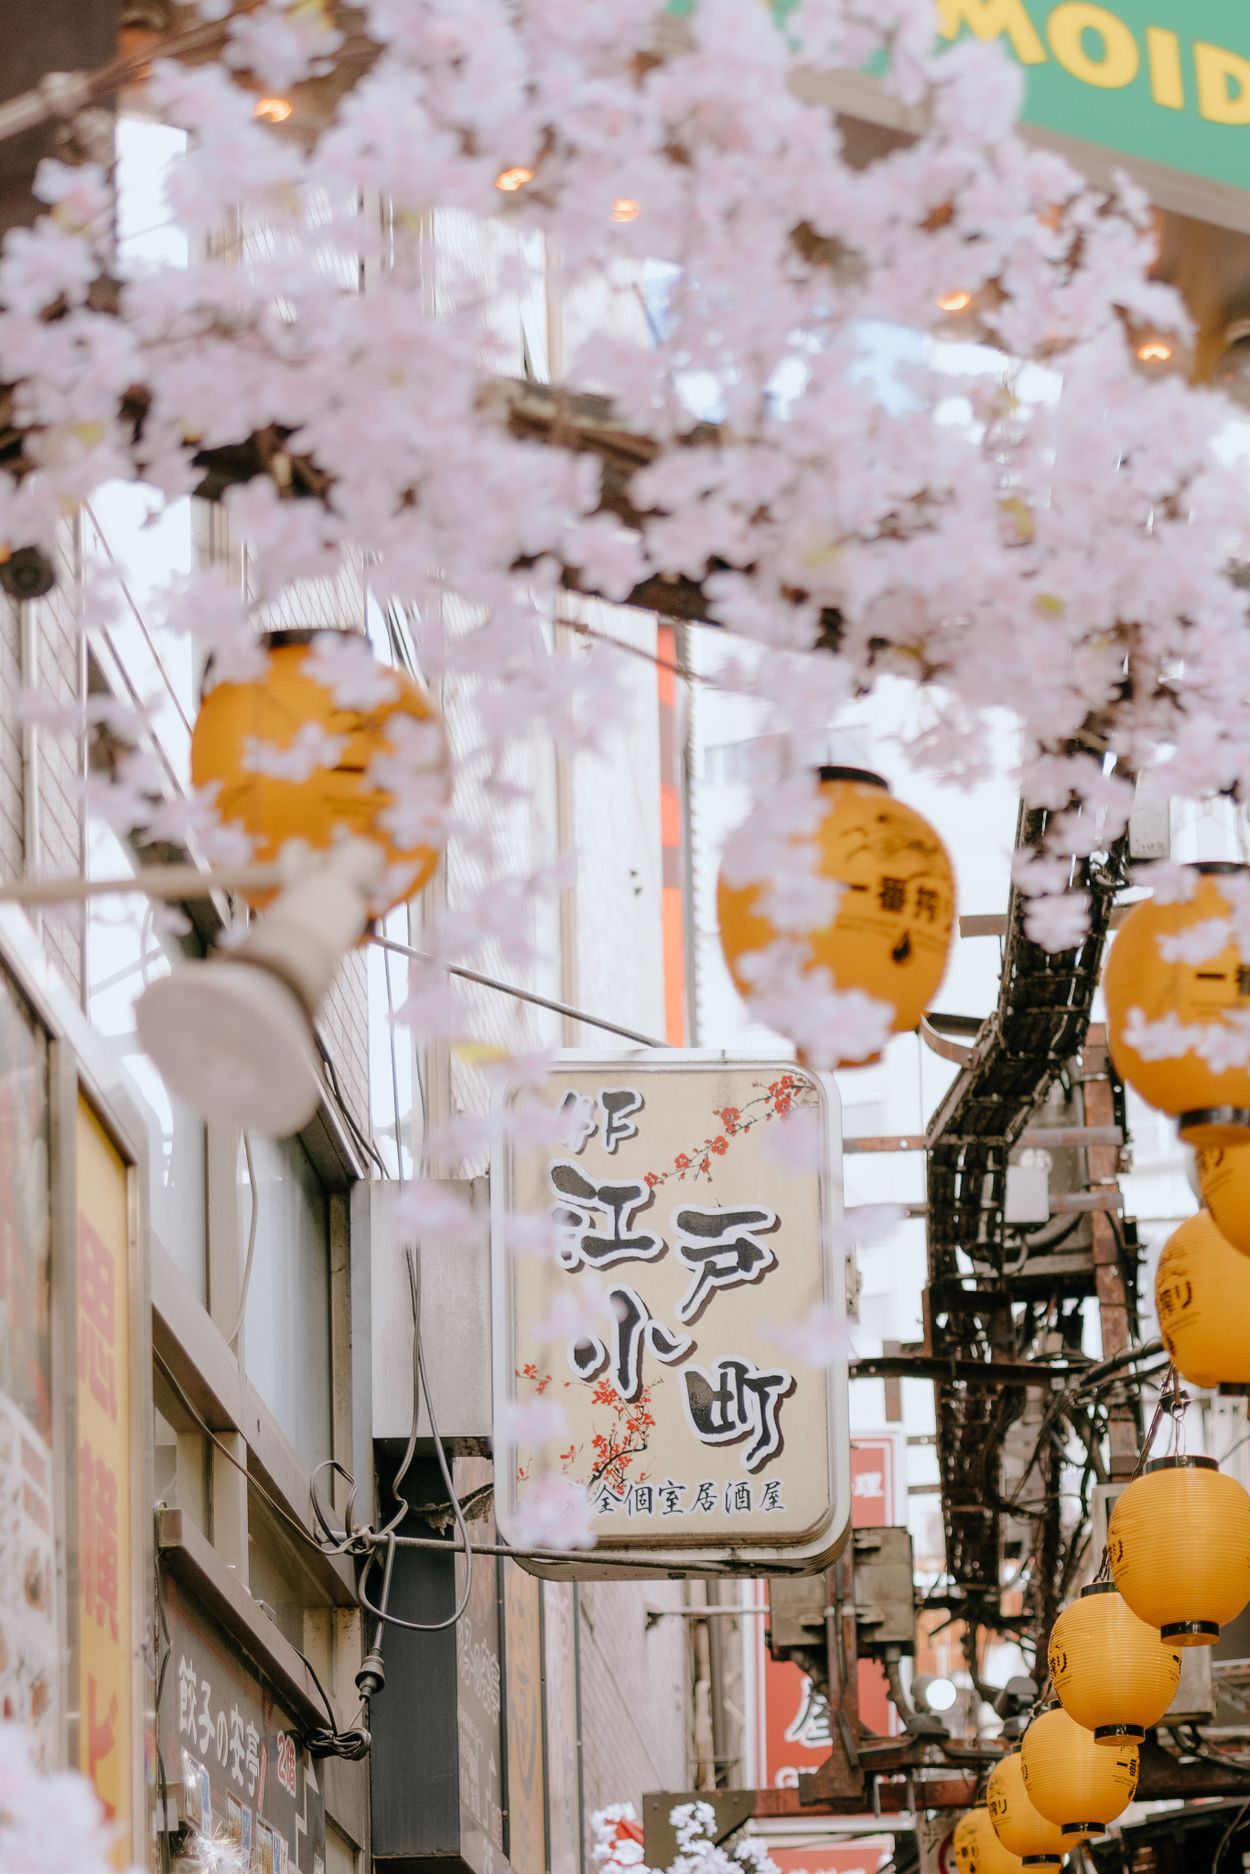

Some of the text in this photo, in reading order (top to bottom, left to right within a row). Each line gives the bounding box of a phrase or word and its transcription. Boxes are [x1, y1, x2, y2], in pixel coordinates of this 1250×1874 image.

[592, 1479, 786, 1517] 全個室居酒屋
